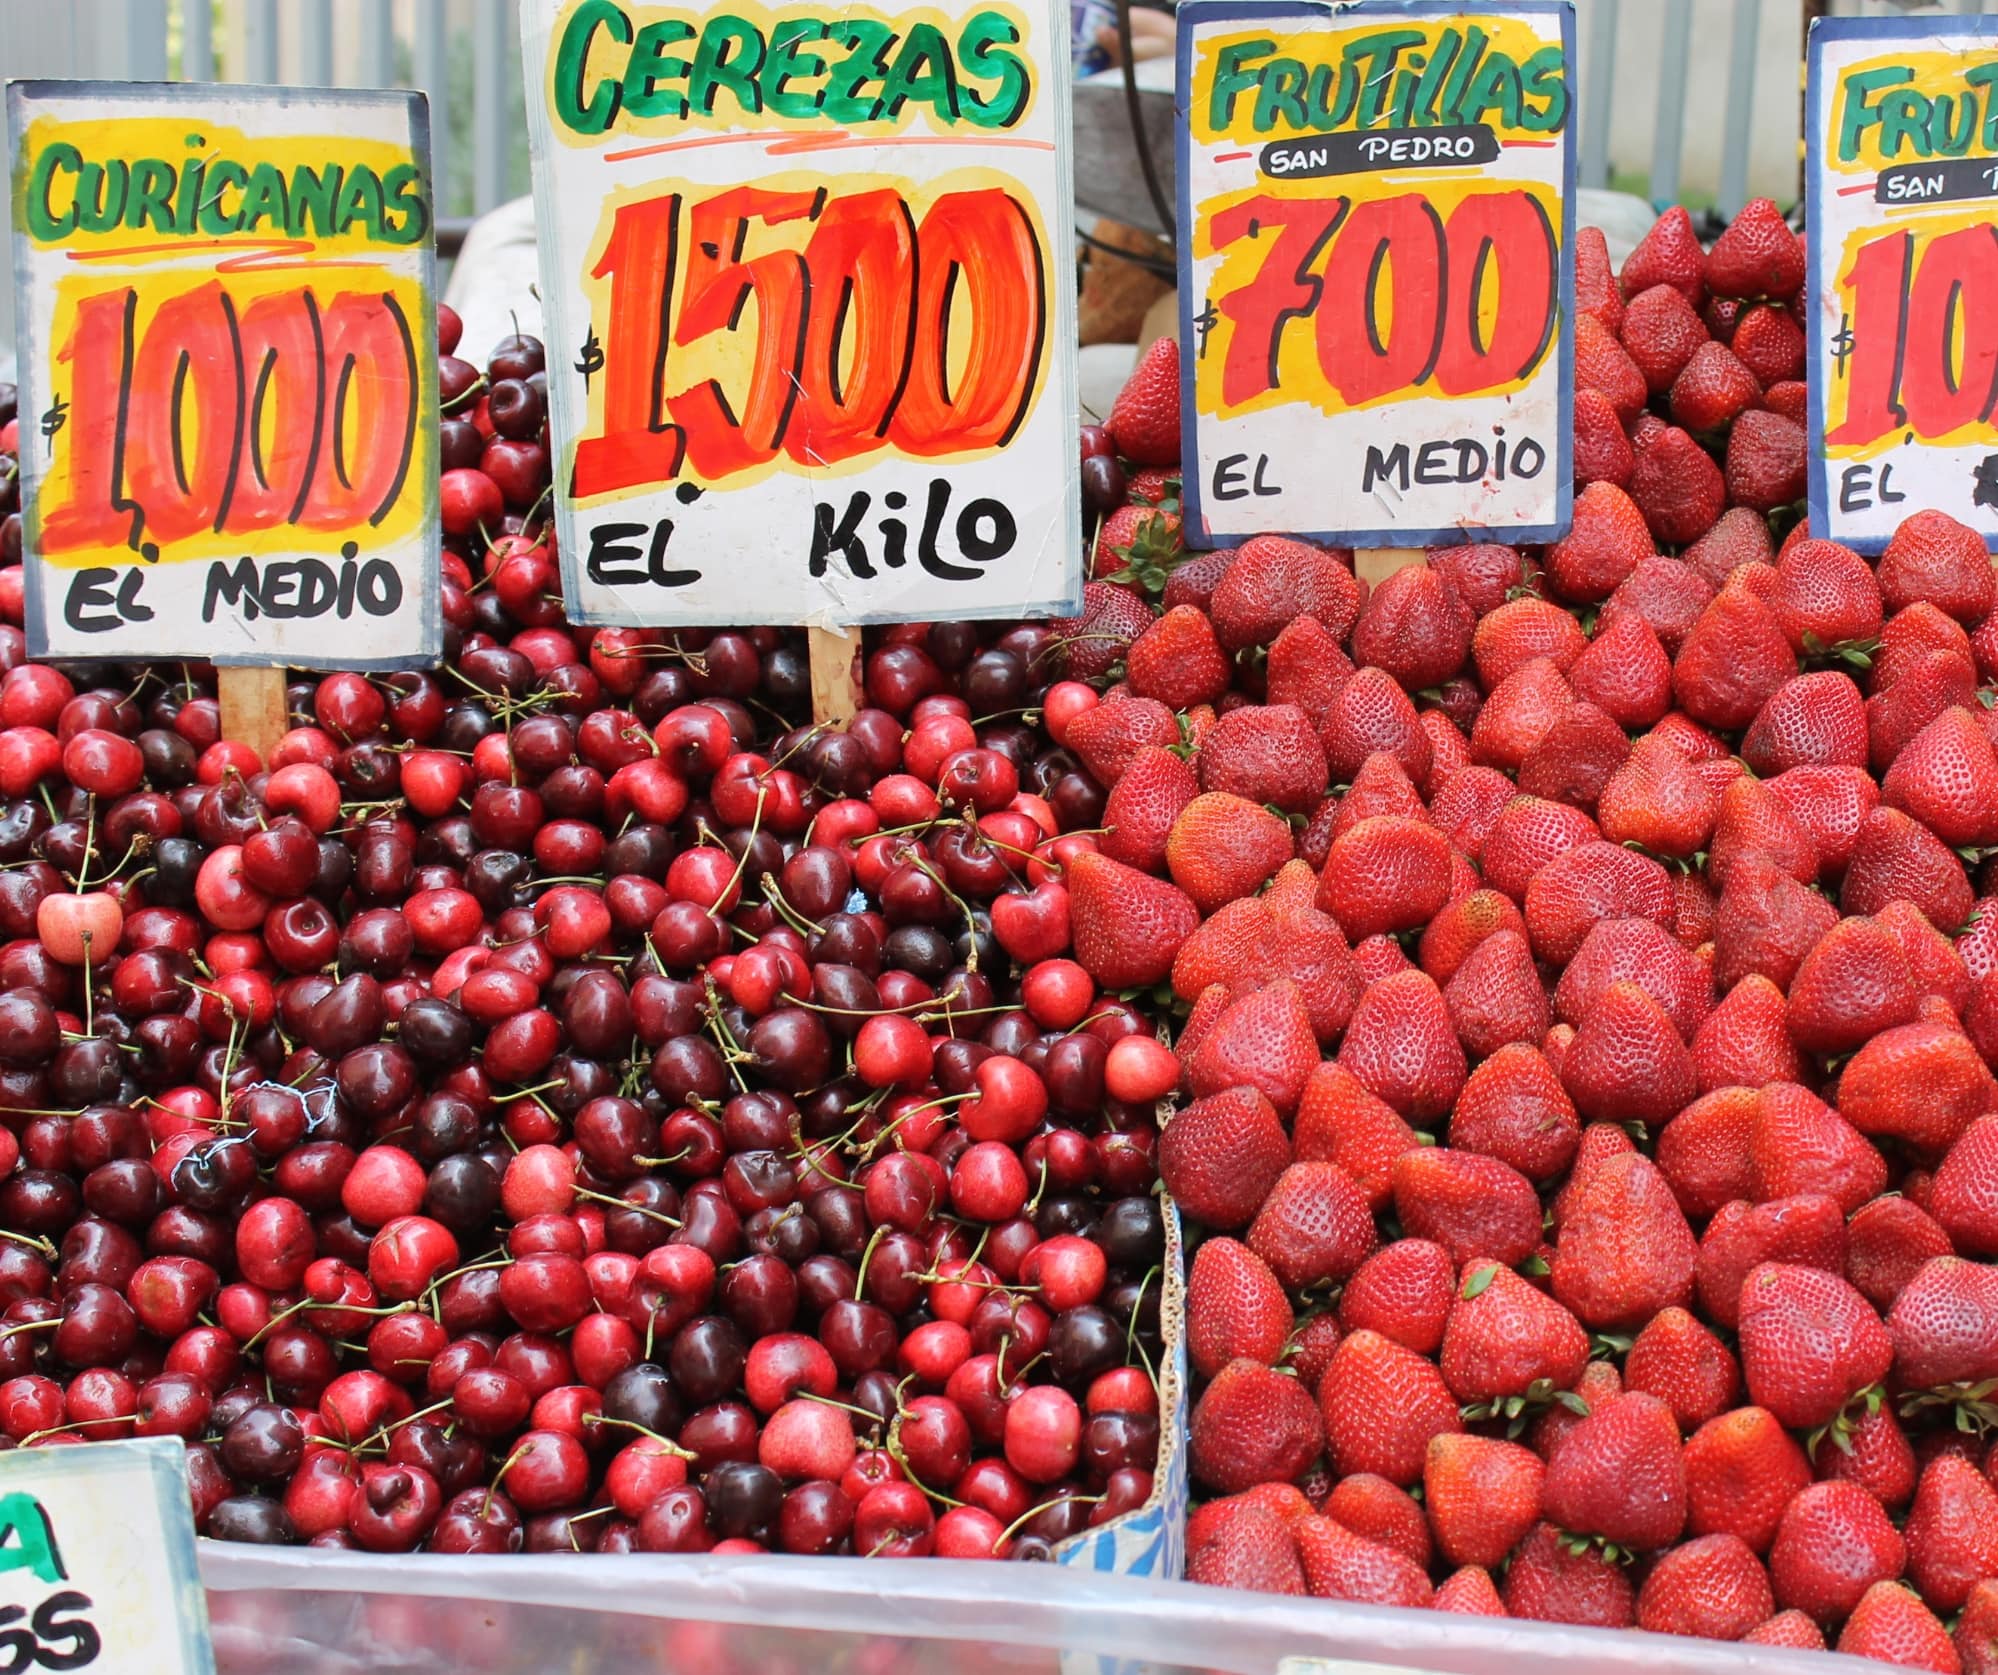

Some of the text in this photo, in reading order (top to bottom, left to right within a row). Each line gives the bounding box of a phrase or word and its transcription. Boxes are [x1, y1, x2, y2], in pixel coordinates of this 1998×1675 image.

[554, 2, 1032, 136] CEREZAS
[1268, 134, 1476, 174] SAN PEDRO
[1887, 174, 1945, 199] SAN
[1211, 453, 1283, 500] EL
[1840, 463, 1906, 514] EL
[586, 518, 702, 587] EL
[64, 566, 156, 633] EL
